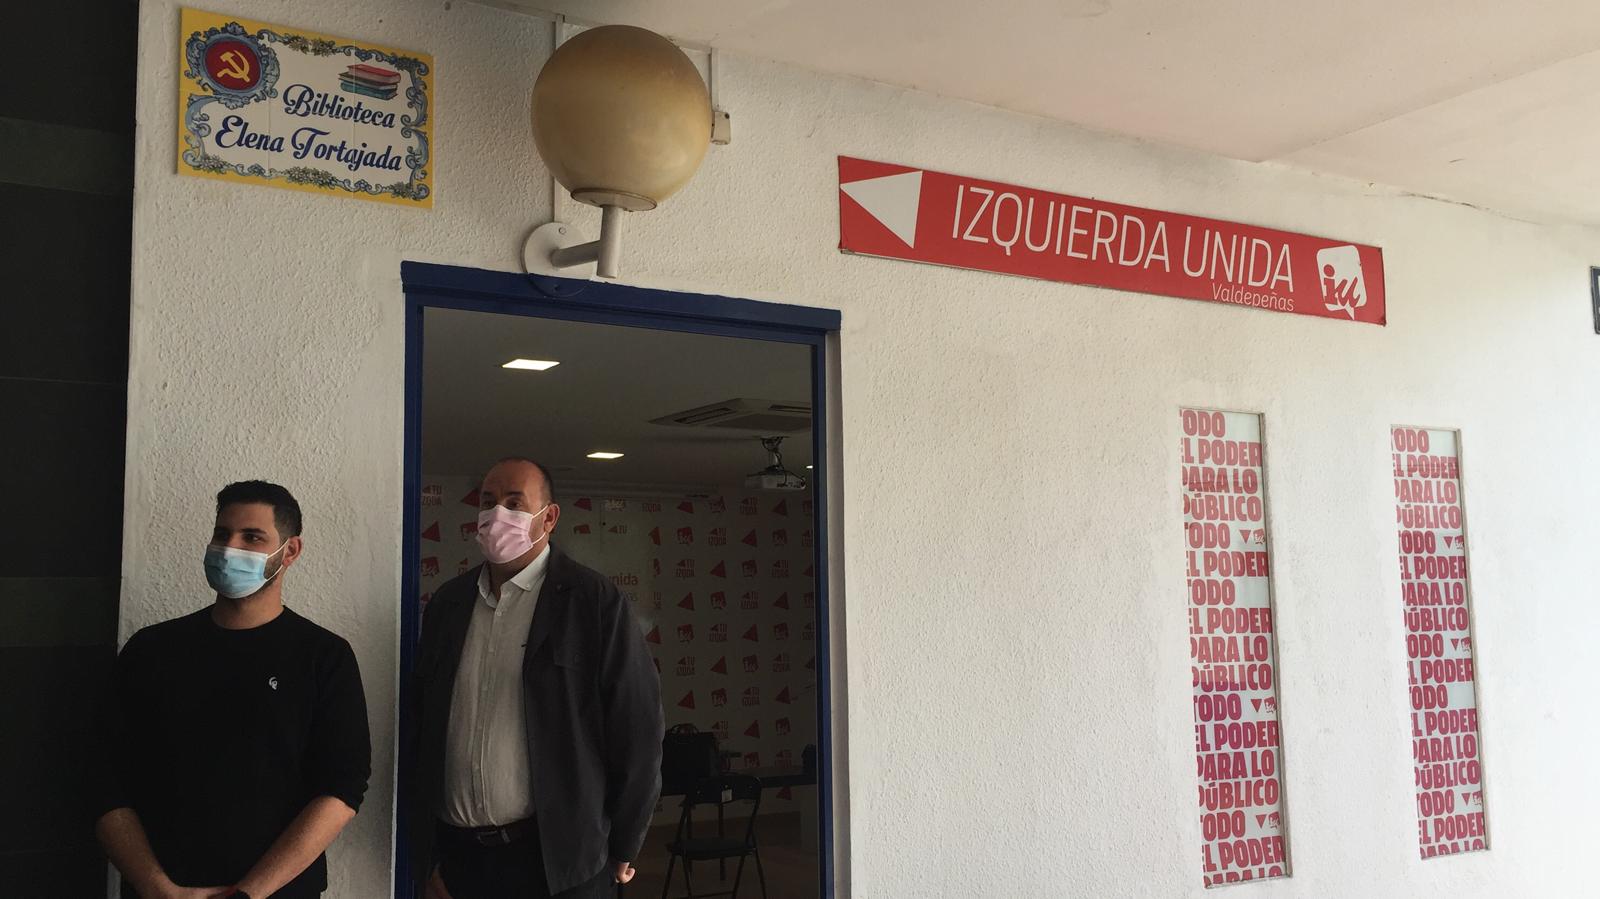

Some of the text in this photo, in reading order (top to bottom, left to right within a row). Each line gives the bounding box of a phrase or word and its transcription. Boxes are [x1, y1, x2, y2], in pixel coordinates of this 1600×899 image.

[284, 84, 394, 128] Biblioteca
[215, 115, 401, 171] Elena Tortajada
[953, 184, 1294, 292] IZQUIERDA UNIDA
[1212, 282, 1294, 312] Valdepeñas
[1180, 409, 1225, 437] ODO
[1181, 438, 1262, 466] L PODER
[1391, 428, 1429, 453] ODO
[1392, 454, 1459, 479] L PODER
[1233, 469, 1258, 494] LO
[1437, 480, 1456, 504] LO
[1399, 530, 1436, 554] ODO
[1186, 551, 1268, 576] L PODER
[1414, 556, 1467, 579] PODER
[1444, 582, 1464, 605] LO
[1189, 608, 1272, 634] L PODER
[1404, 607, 1468, 632] ÚBLICO
[1244, 636, 1268, 661] LO
[1405, 634, 1444, 658] ODO
[1407, 658, 1474, 685] L PODER
[1409, 684, 1448, 710] ODO
[1411, 708, 1478, 736] L PODER
[1214, 721, 1279, 750] PODER
[1456, 734, 1476, 759] LO
[1251, 750, 1274, 777] LO
[1200, 810, 1245, 841] ODO
[1418, 812, 1485, 844] L PODER
[1202, 836, 1286, 872] L PODER
